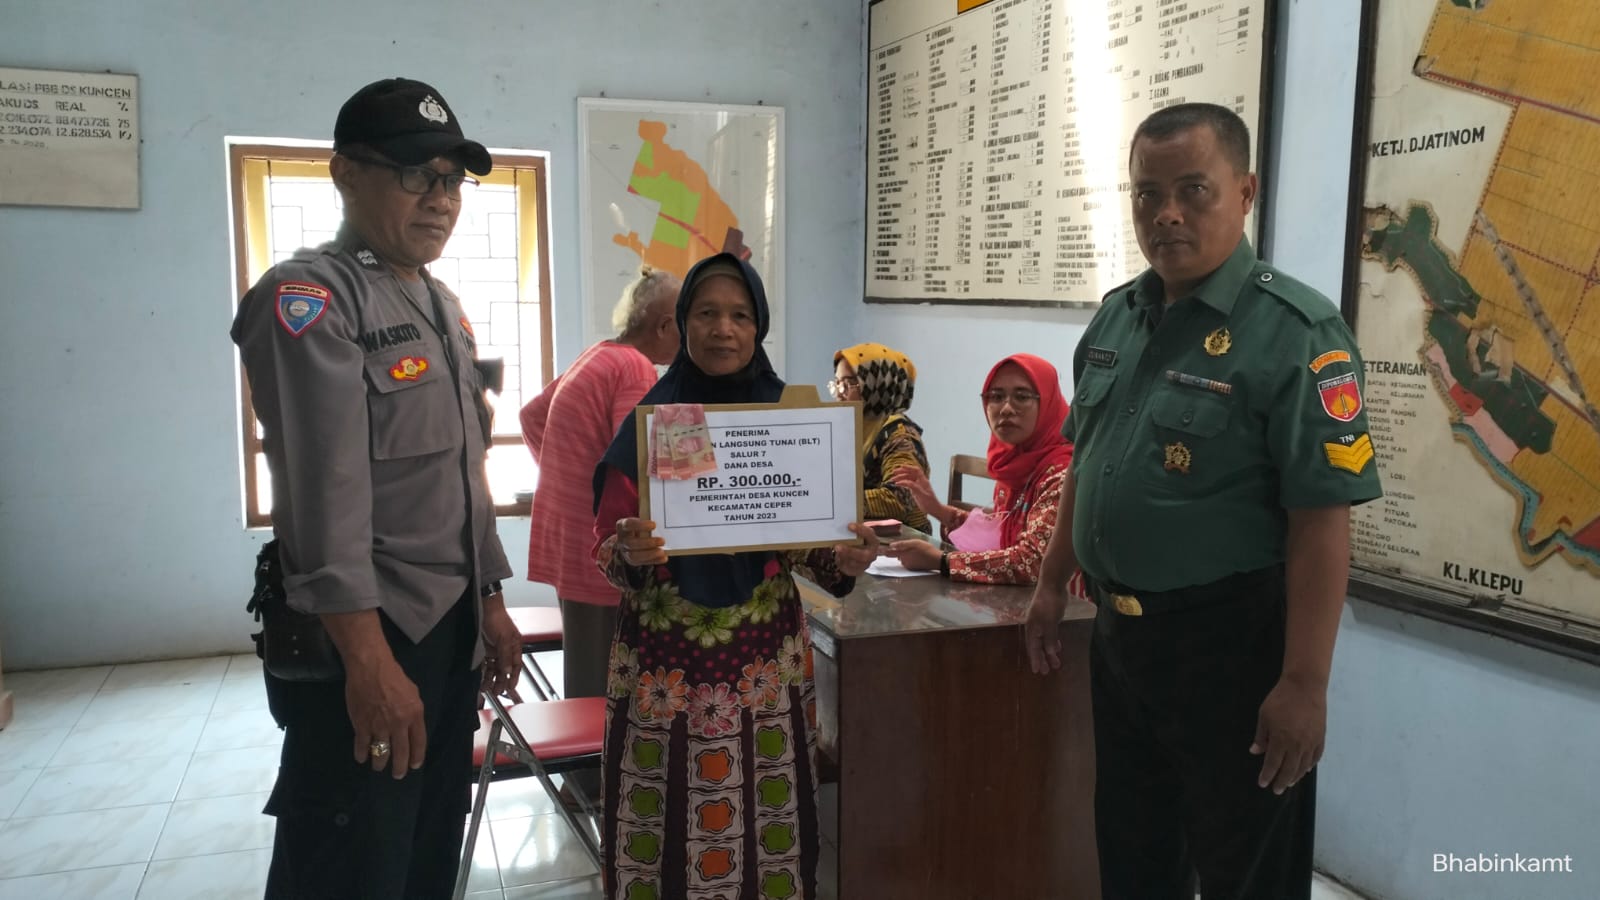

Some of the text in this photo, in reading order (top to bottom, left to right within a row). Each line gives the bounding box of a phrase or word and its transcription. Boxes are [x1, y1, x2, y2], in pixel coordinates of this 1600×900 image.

[79, 86, 131, 98] KUNCEN
[55, 101, 86, 112] REAL
[361, 323, 421, 353] WASKITO
[1363, 361, 1427, 376] ETERANGAN
[725, 429, 770, 437] PENERIMA
[1339, 434, 1355, 443] TNI
[719, 440, 767, 448] LANGSUNG
[798, 437, 821, 446] (BLT)
[730, 451, 759, 459] SALUR
[697, 473, 801, 488] RP. 300.000,-
[690, 490, 809, 502] PEMERINTAH DESA KUNCEN
[708, 501, 792, 512] KECAMATAN CEPER
[724, 512, 777, 521] TAHUN 2023
